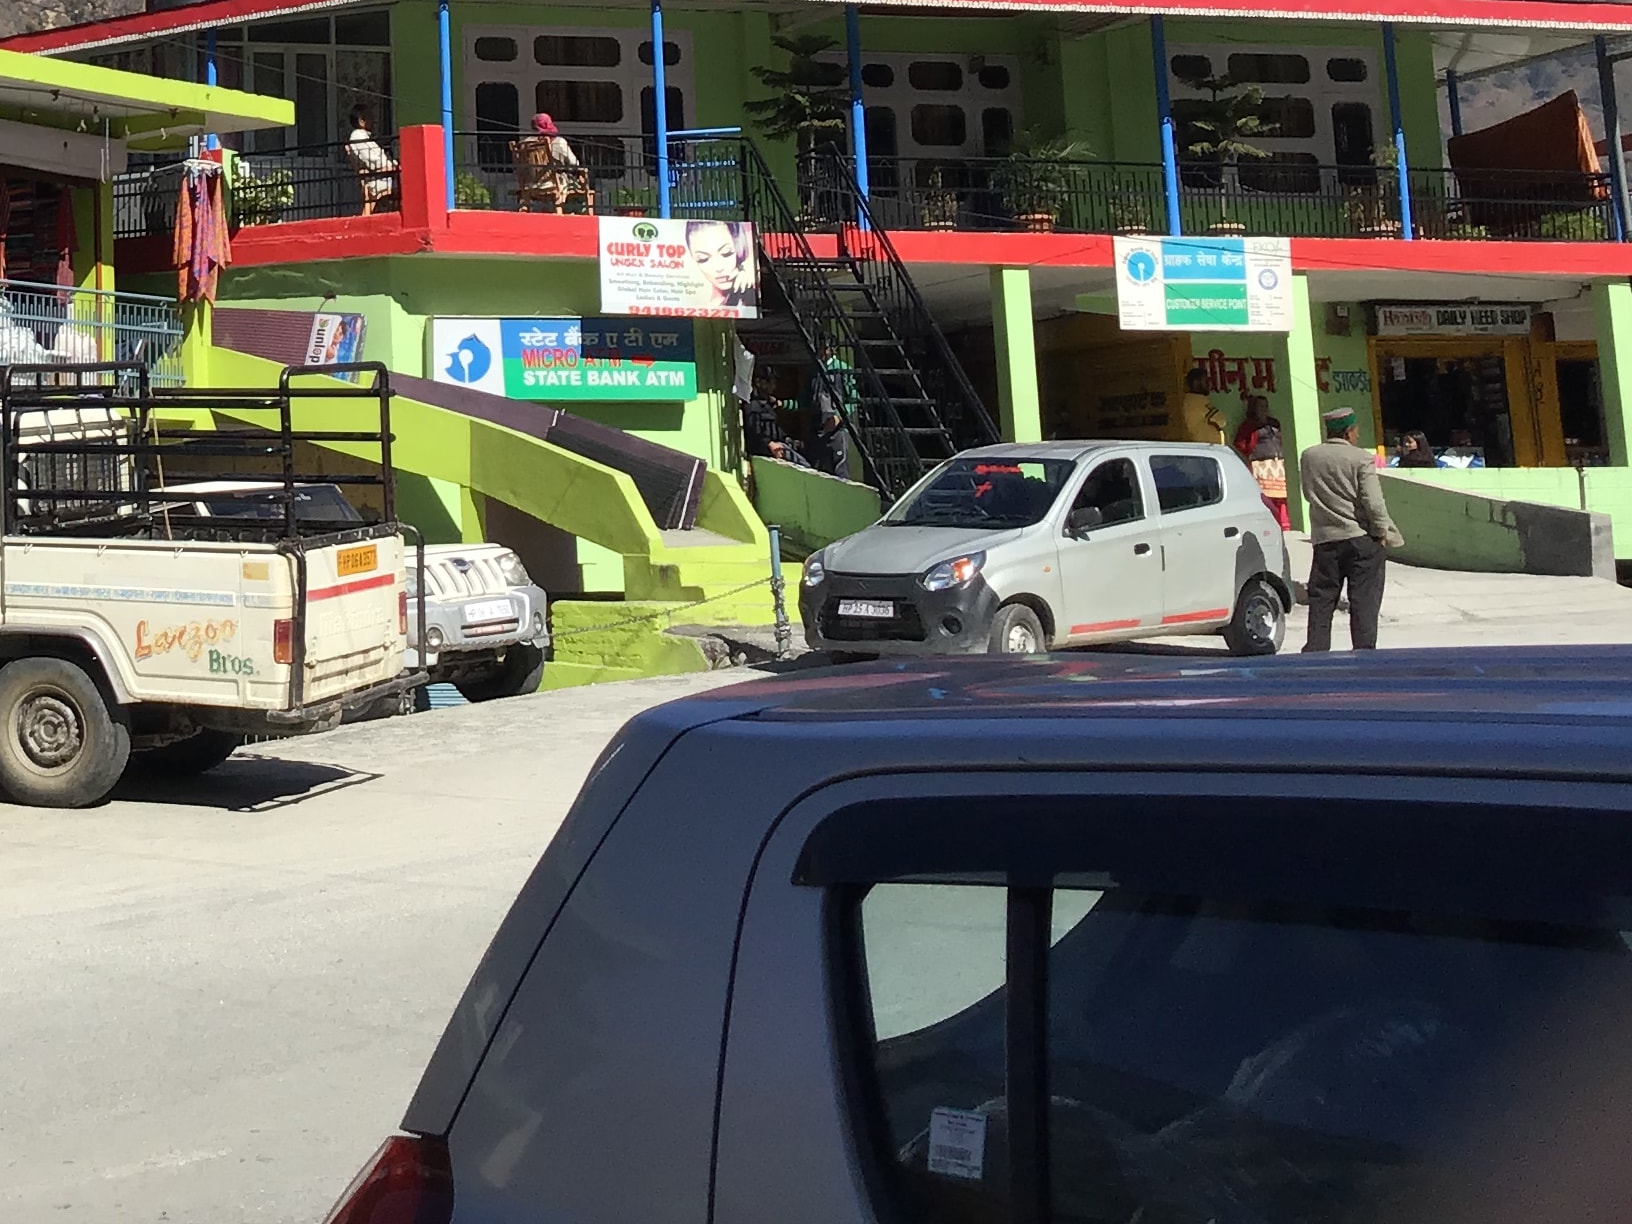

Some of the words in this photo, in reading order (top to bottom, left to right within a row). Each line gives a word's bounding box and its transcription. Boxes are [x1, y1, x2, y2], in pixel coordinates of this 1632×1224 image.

[606, 242, 651, 257] CURLY
[656, 244, 686, 258] TOP
[610, 258, 645, 268] UNISEX
[650, 259, 684, 269] SALON
[1436, 310, 1466, 325] DAILY
[1500, 310, 1527, 325] SHOP
[519, 327, 557, 347] स्टेट
[564, 326, 599, 347] बैंक
[605, 331, 618, 348] ए
[623, 328, 644, 347] टी
[649, 331, 678, 348] एम
[521, 348, 577, 368] MICRO
[584, 351, 623, 368] ATM
[523, 370, 582, 386] STATE
[587, 370, 640, 386] BANK
[645, 370, 684, 386] ATM
